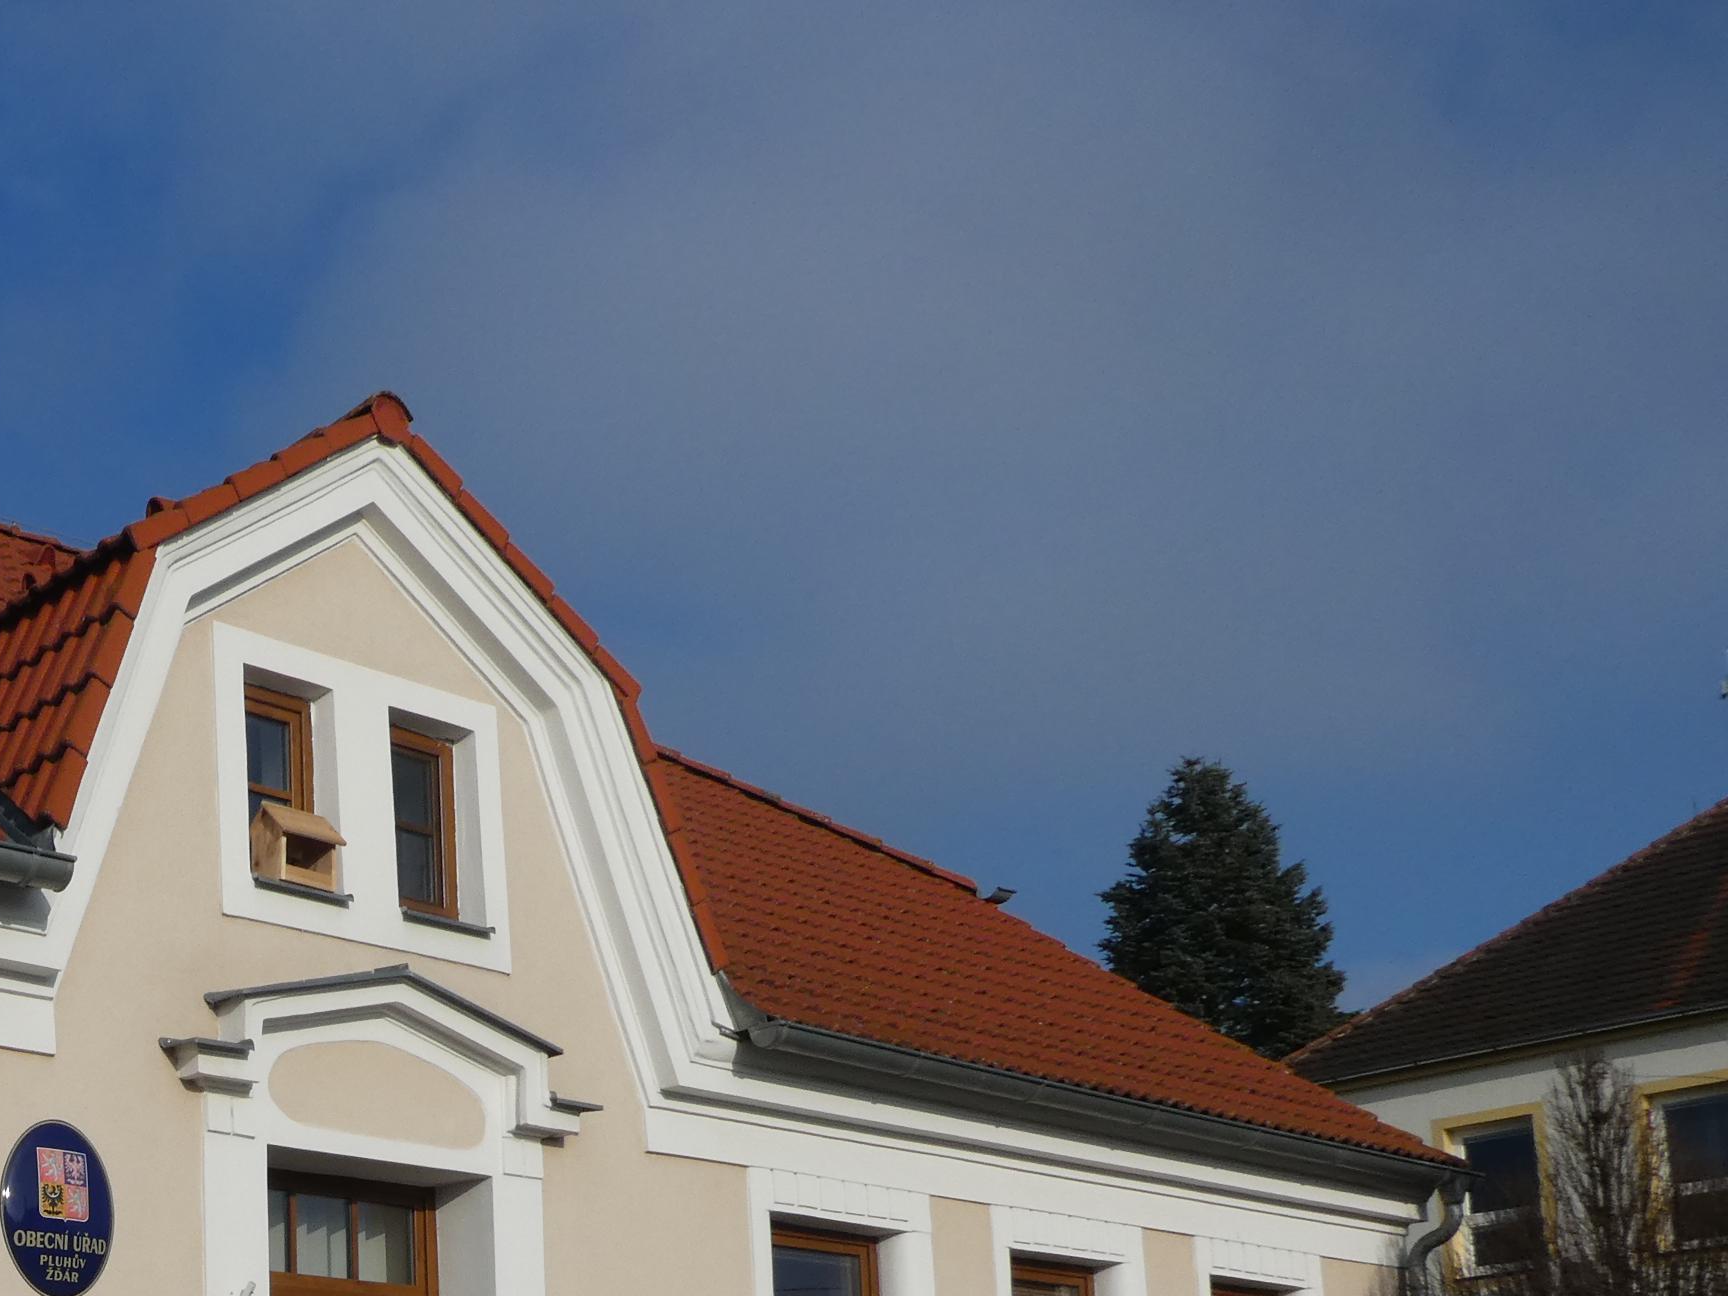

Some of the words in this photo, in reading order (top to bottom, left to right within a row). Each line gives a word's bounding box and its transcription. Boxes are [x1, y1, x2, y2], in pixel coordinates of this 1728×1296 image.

[13, 1229, 68, 1250] OBECNÍ
[73, 1231, 106, 1254] ÚŘAD
[39, 1254, 86, 1268] PLUHŮV
[45, 1267, 79, 1282] ŽĎÁR
